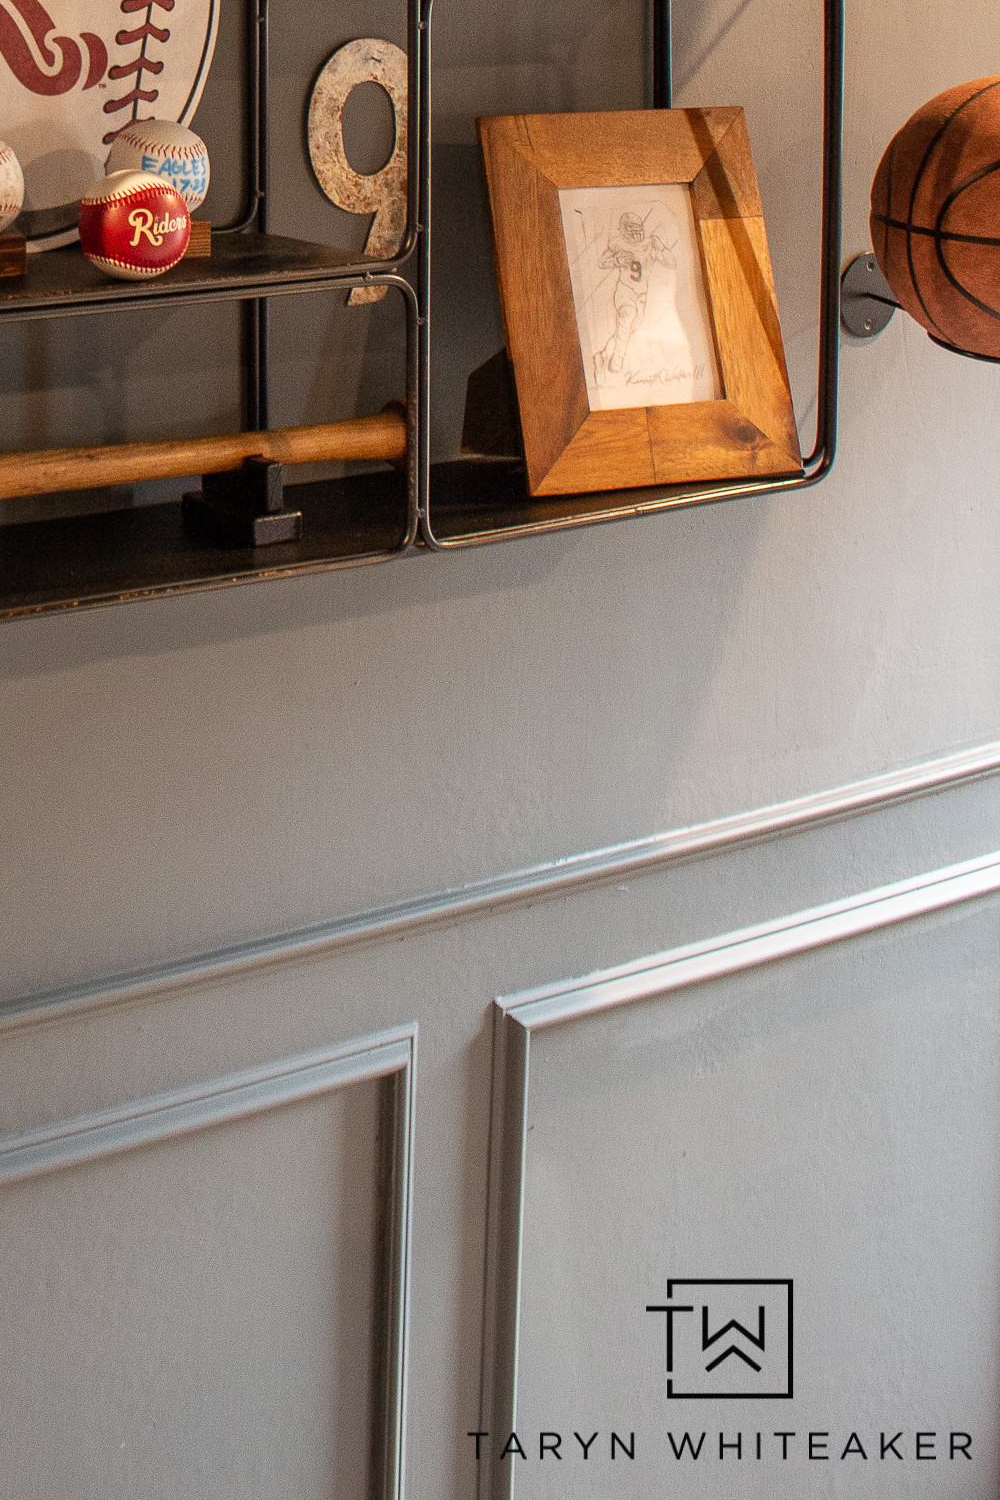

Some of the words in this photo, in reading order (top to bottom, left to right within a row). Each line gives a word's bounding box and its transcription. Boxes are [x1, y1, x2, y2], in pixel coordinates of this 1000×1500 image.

[141, 155, 206, 176] EAGLES
[128, 208, 187, 246] Riders
[630, 260, 642, 282] 9
